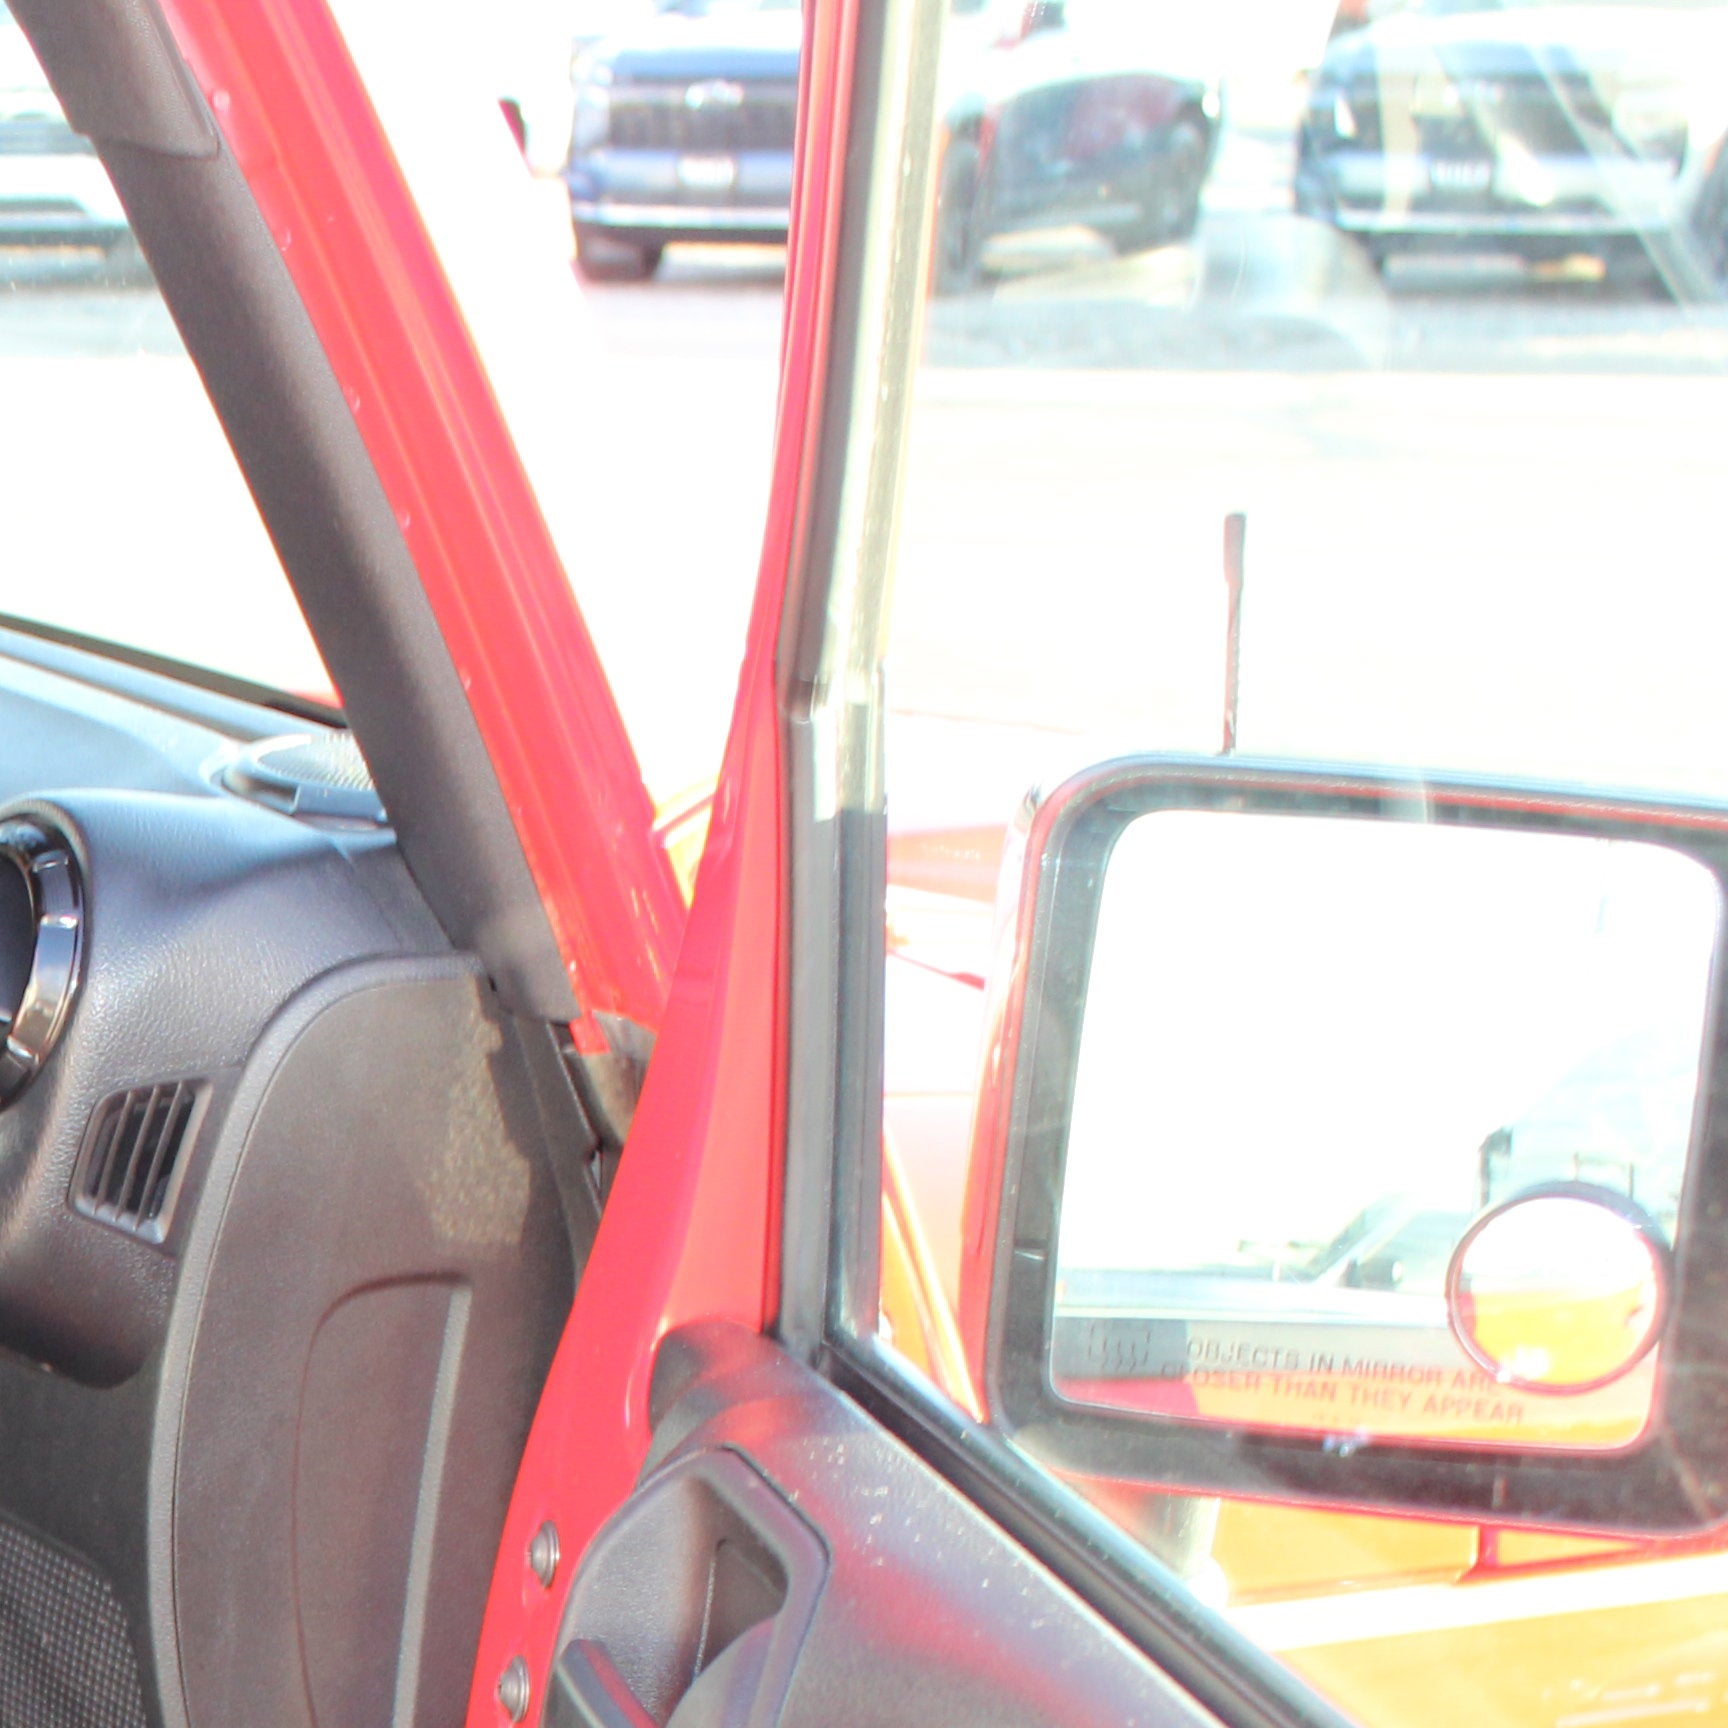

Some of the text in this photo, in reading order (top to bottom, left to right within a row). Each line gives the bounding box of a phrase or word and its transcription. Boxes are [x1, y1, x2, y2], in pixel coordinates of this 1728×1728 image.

[1309, 1350, 1335, 1374] IN
[1341, 1356, 1443, 1388] MIRROR
[1349, 1383, 1414, 1413] THEY
